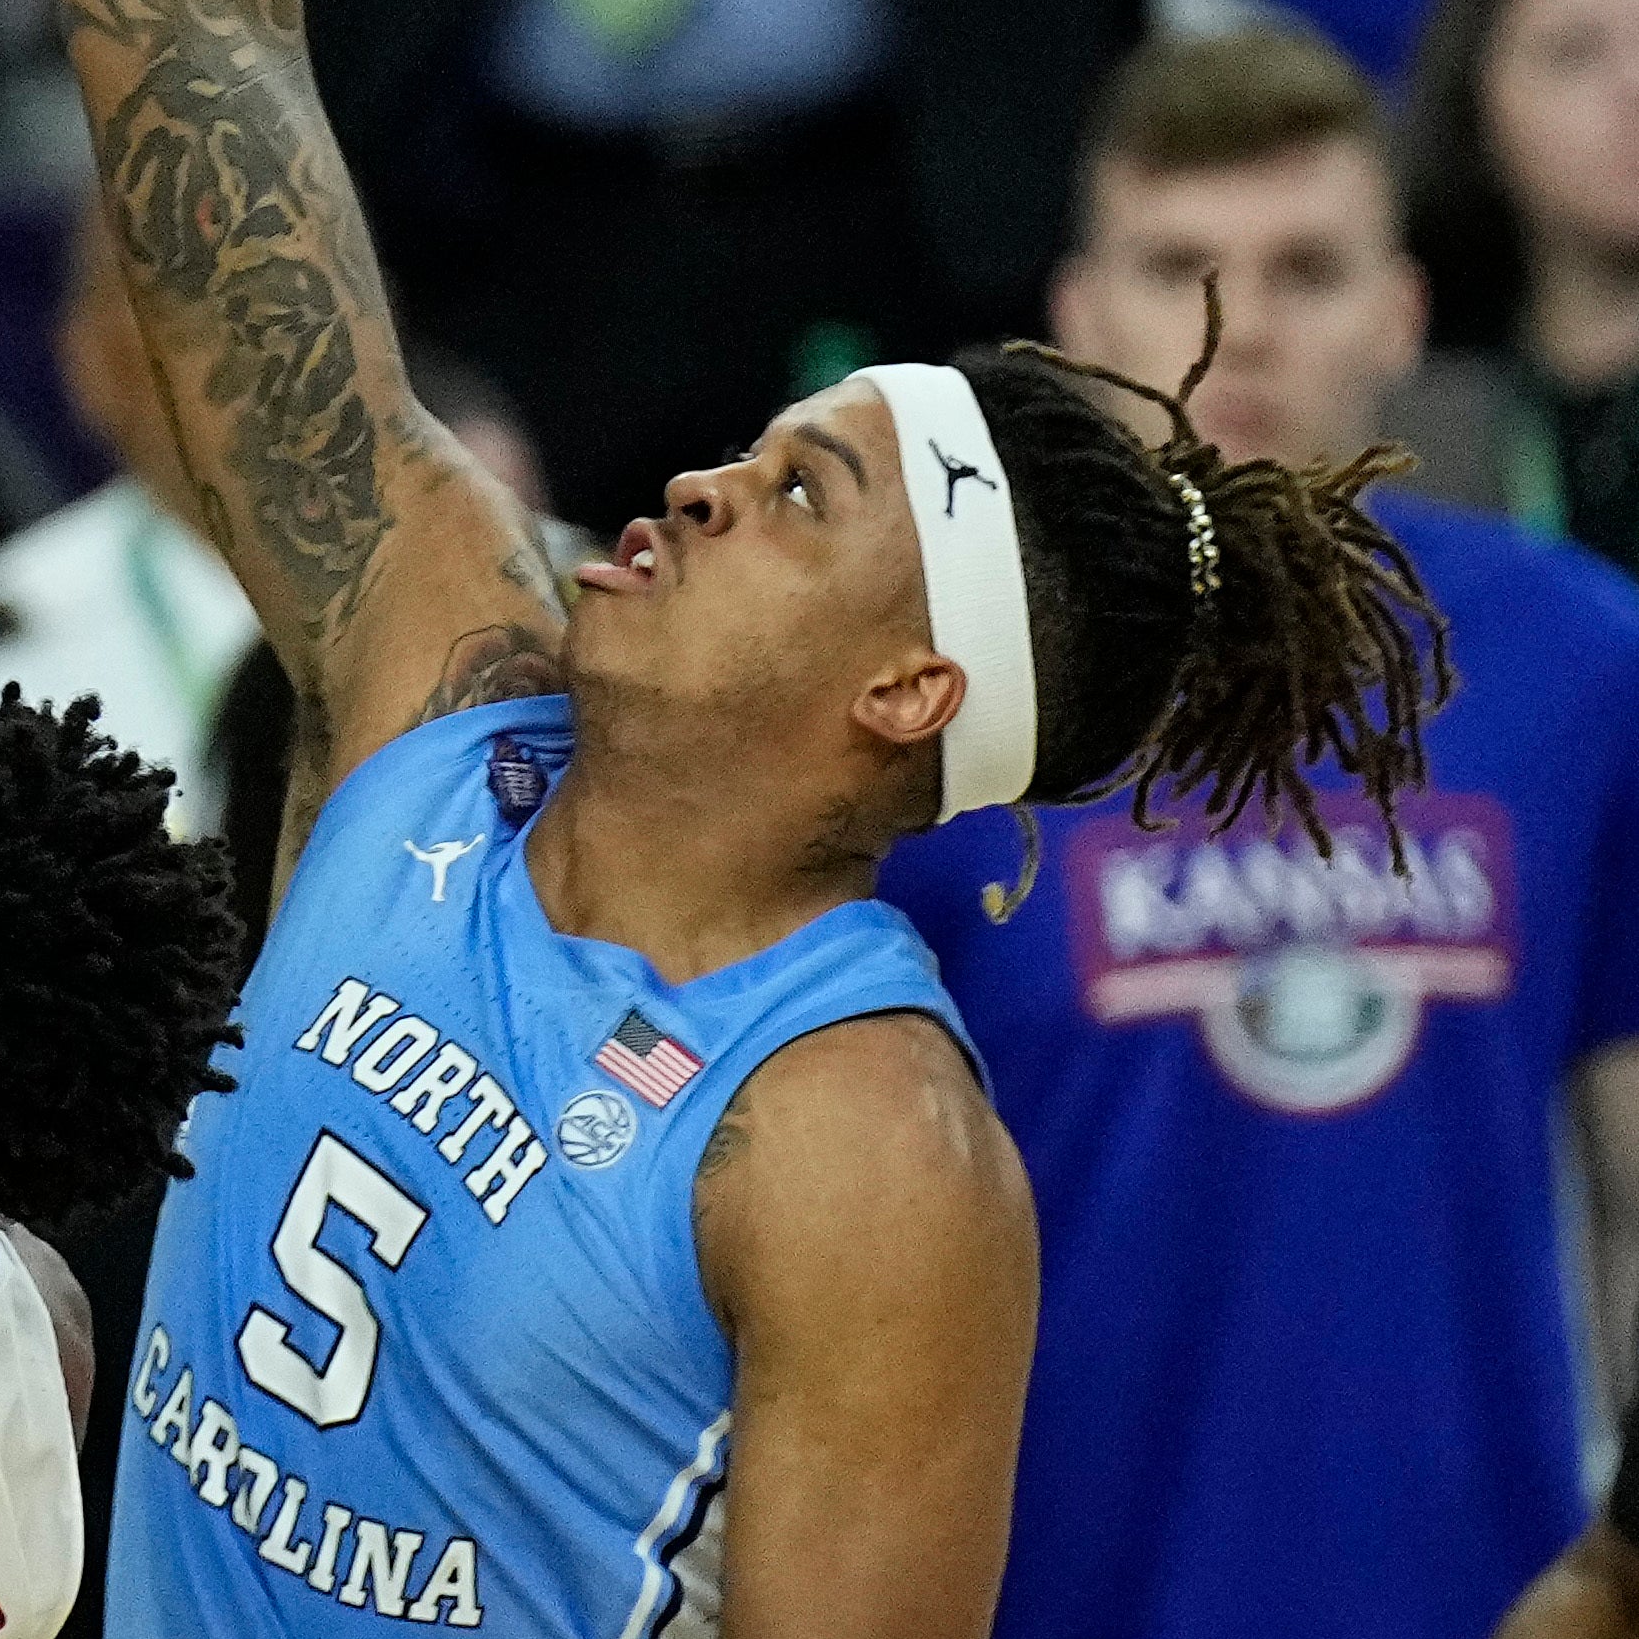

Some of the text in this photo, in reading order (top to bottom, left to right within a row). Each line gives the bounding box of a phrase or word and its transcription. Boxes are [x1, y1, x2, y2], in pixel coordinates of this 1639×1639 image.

[296, 976, 549, 1227] NORTH
[235, 1126, 431, 1429] 5
[132, 1322, 484, 1629] CAROLINA
